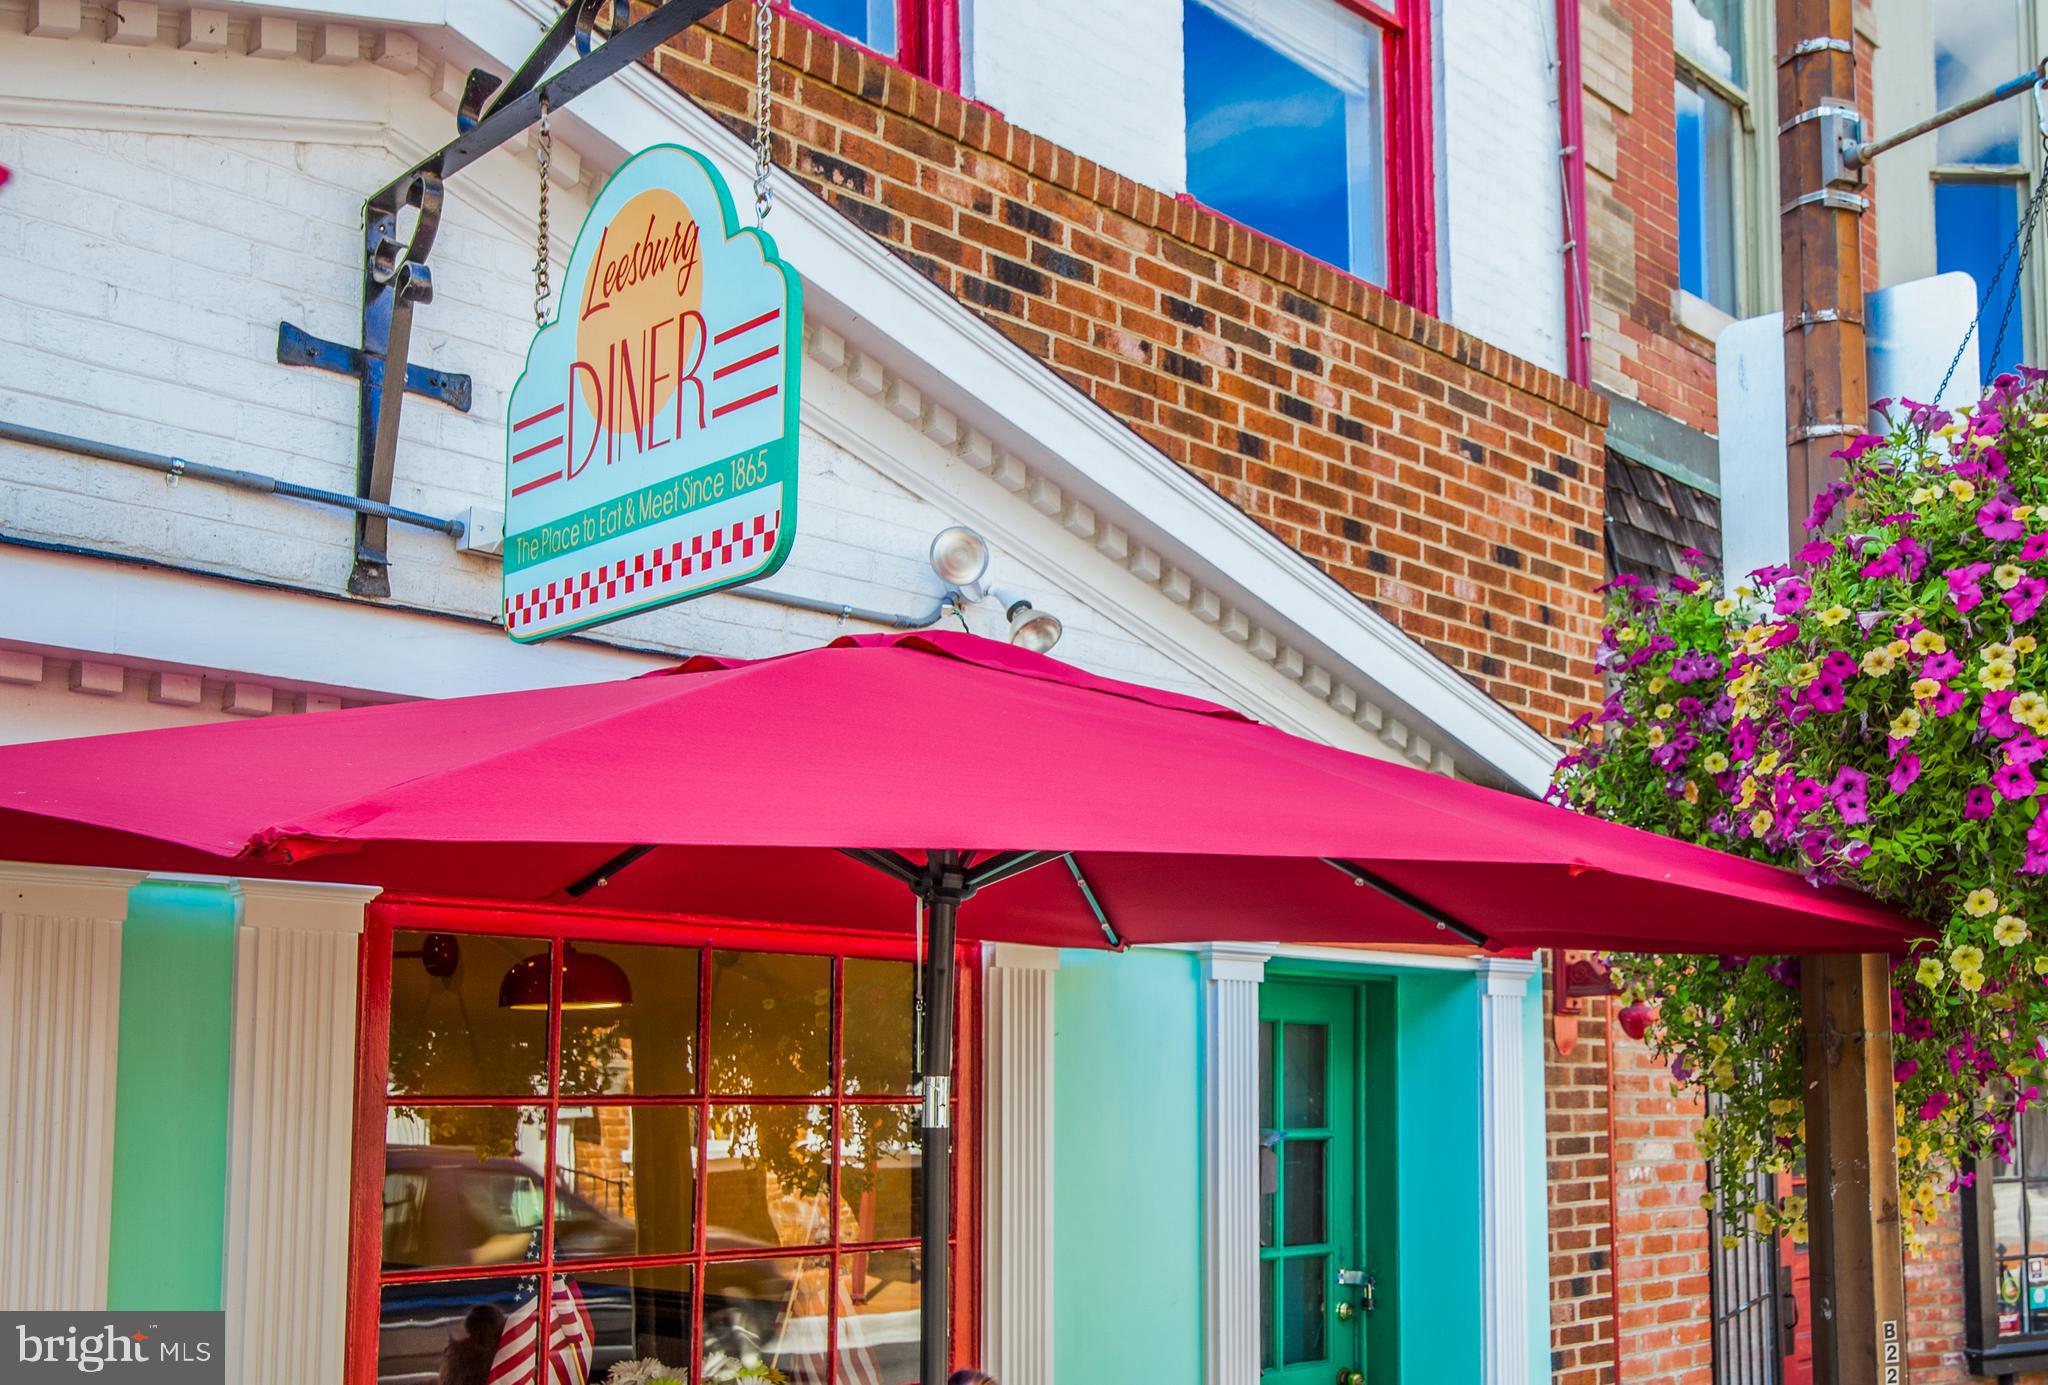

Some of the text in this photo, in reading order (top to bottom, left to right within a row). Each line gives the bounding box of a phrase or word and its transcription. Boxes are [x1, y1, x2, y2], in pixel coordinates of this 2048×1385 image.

[582, 214, 700, 321] Leesburg
[567, 310, 708, 481] DINER
[516, 449, 768, 564] The Place to Eat & Meet Since 1865
